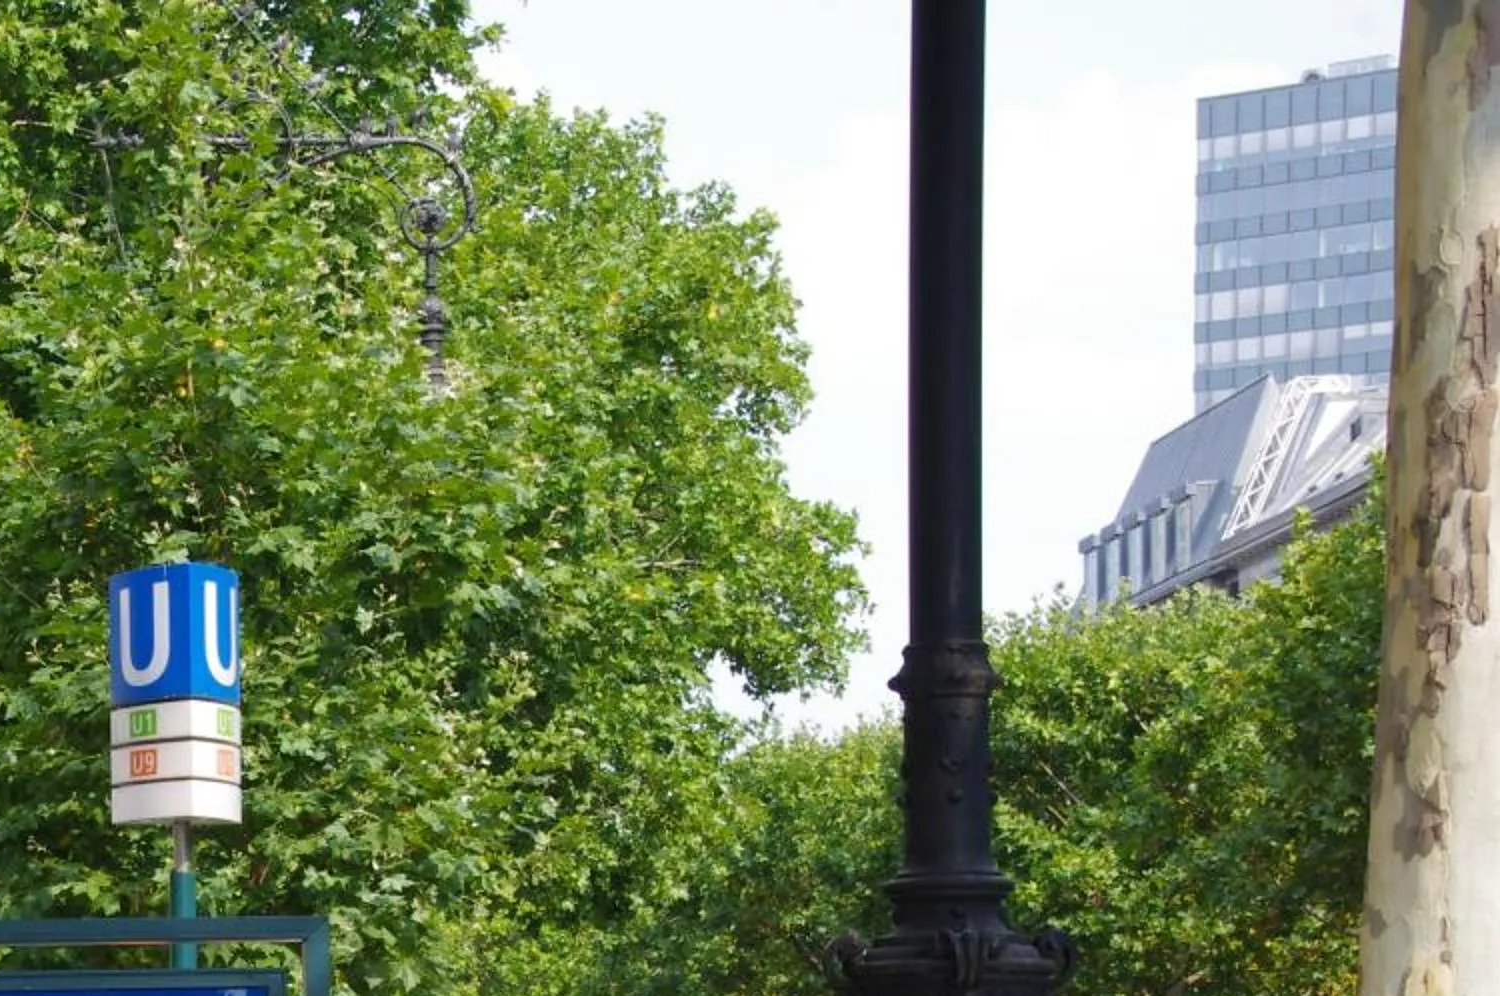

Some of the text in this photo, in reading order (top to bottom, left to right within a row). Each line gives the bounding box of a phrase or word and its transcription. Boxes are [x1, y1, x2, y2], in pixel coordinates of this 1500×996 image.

[120, 581, 170, 686] U
[204, 581, 236, 686] U
[133, 751, 156, 775] U9
